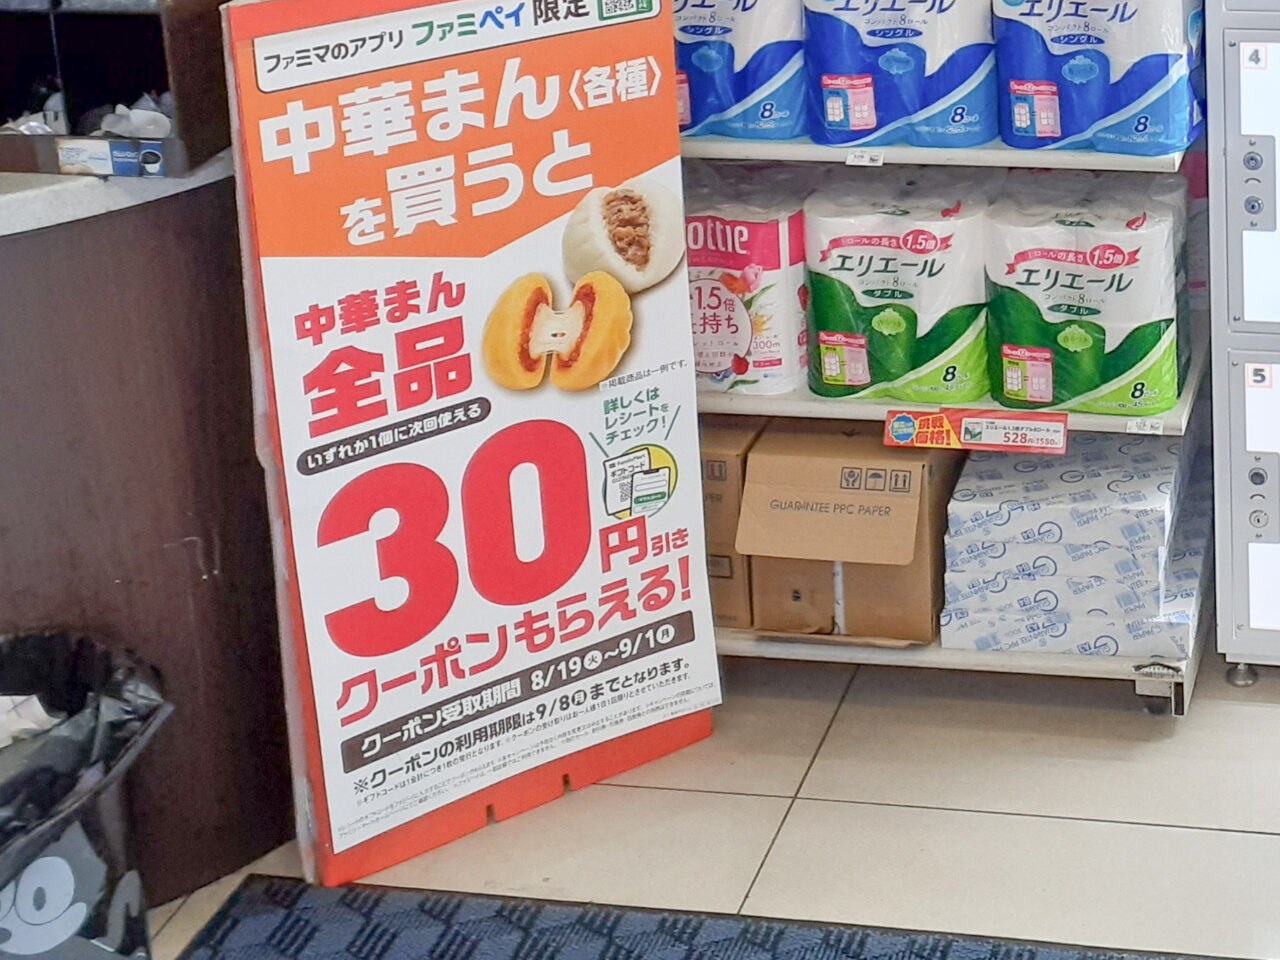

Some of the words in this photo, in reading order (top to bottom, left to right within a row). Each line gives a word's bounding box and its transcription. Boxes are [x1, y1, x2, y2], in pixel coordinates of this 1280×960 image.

[264, 29, 404, 73] ファミマのアプリ
[411, 3, 525, 46] ファミペイ
[1248, 48, 1261, 65] 4
[340, 128, 594, 246] を買うと
[687, 220, 749, 254] ottie
[829, 253, 946, 278] エリエール
[1091, 249, 1124, 267] 1.5倍
[1015, 268, 1134, 293] エリエール
[294, 271, 466, 347] 中華まん
[303, 315, 474, 439] 全品
[1253, 368, 1266, 383] 5
[603, 387, 661, 416] 詳しくは
[604, 402, 670, 430] レシートを
[306, 402, 482, 470] いずれか1個に次回使える
[605, 415, 668, 446] チェック!
[833, 502, 855, 516] PPC
[857, 504, 892, 518] PAPER
[336, 555, 692, 728] クーポンもらえる!
[360, 676, 522, 760] クーポン受取期間
